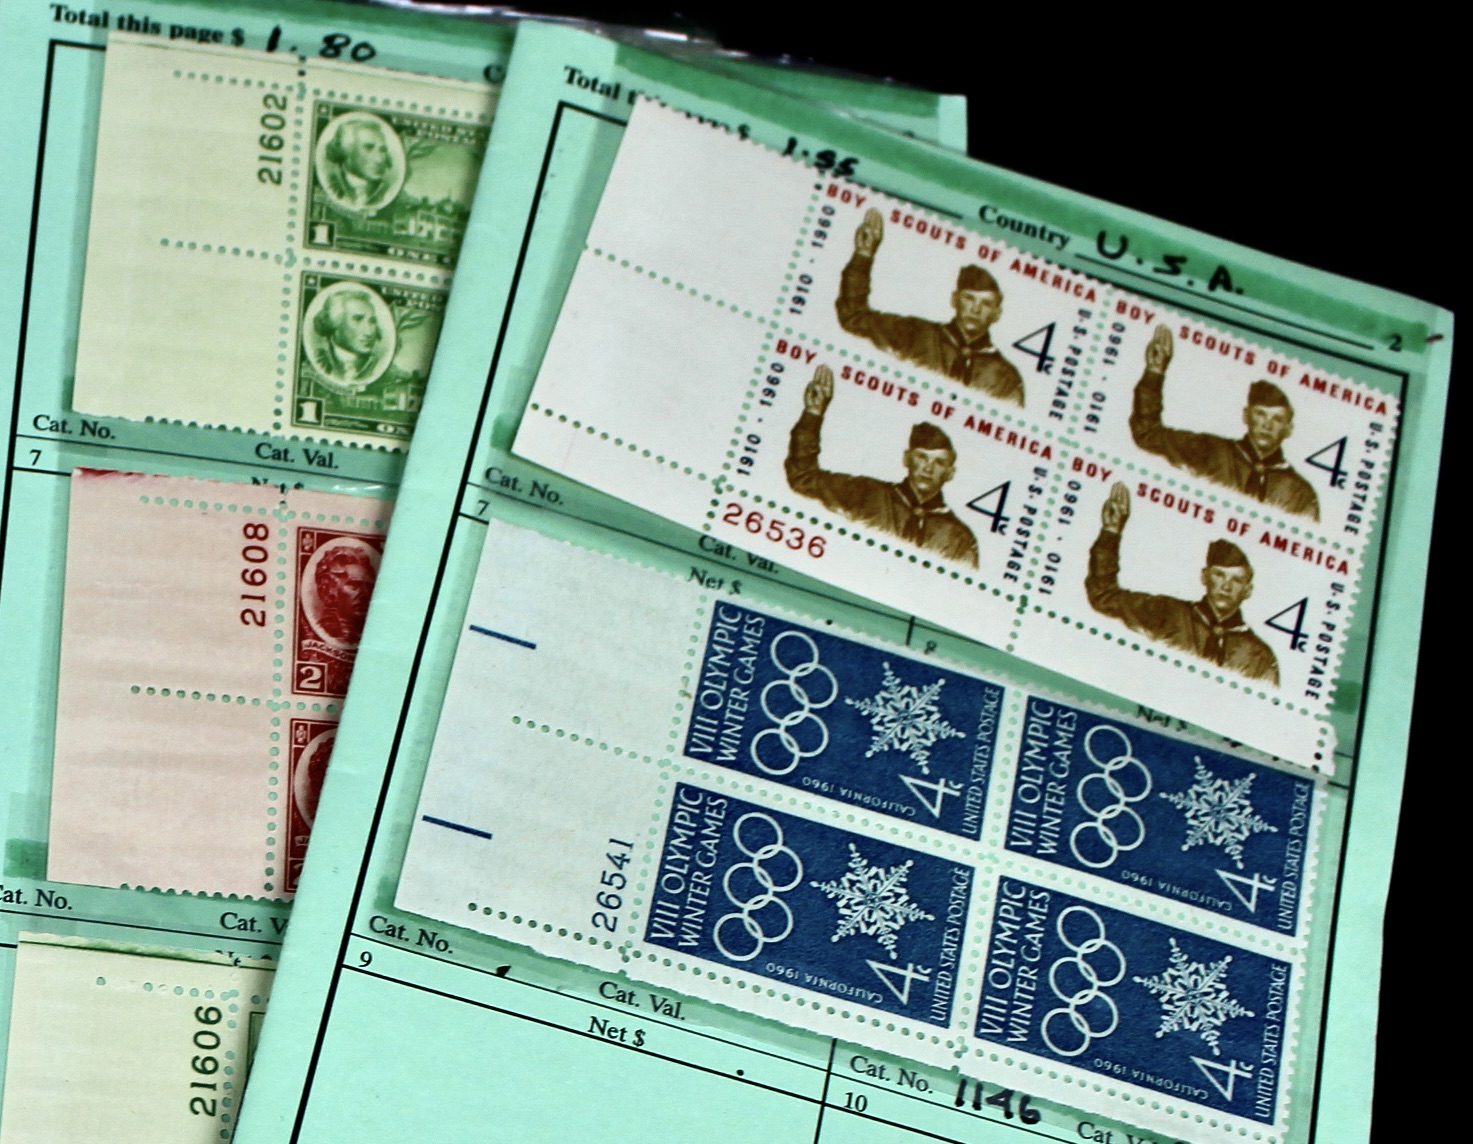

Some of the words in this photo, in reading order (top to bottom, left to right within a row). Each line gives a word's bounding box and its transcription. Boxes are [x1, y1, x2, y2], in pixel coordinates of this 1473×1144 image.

[49, 4, 109, 28] Total
[117, 11, 161, 34] this
[165, 22, 224, 45] page
[230, 27, 245, 46] $
[563, 65, 621, 101] Total
[256, 93, 288, 186] 21602
[826, 184, 866, 209] BOY
[890, 210, 966, 250] SCOUTS
[979, 246, 1001, 263] OF
[1011, 259, 1096, 301] AMERICA
[979, 205, 1070, 252] Country
[1096, 230, 1245, 296] U.S.A.
[1115, 300, 1156, 325] BOY
[1179, 325, 1256, 366] SCOUTS
[1267, 361, 1290, 379] OF
[1299, 373, 1388, 416] AMERICA
[1389, 335, 1402, 351] 2
[1049, 344, 1082, 421] POSTAGE
[32, 414, 73, 434] Cat.
[79, 420, 116, 441] No.
[301, 401, 319, 421] 1
[30, 451, 41, 466] 7
[254, 443, 295, 463] Cat.
[302, 449, 339, 470] Val.
[484, 466, 522, 493] Cat.
[530, 481, 564, 507] No.
[722, 502, 827, 560] 26536
[1071, 457, 1113, 483] BOY
[1136, 482, 1215, 525] SCOUTS
[1227, 517, 1251, 537] OF
[1259, 531, 1349, 576] AMERICA
[240, 522, 269, 626] 21608
[701, 605, 742, 709] OLYMPIC
[732, 614, 765, 686] GAMES
[299, 665, 323, 689] 2
[689, 712, 719, 756] VIII
[717, 687, 750, 764] WINTER
[1050, 710, 1077, 780] GAMES
[1018, 700, 1054, 804] OLYMPIC
[661, 787, 704, 895] OLYMPIC
[695, 797, 728, 869] GAMES
[1010, 804, 1037, 848] VIII
[1037, 781, 1065, 855] WINTER
[35, 889, 73, 910] No.
[591, 838, 634, 933] 26541
[678, 870, 713, 948] WINTER
[949, 867, 970, 927] POSTAGE
[369, 915, 410, 943] Cat.
[416, 929, 454, 955] No.
[651, 896, 681, 940] VIII
[358, 950, 372, 968] 9
[940, 925, 960, 970] STATES
[599, 982, 639, 1007] Cat.
[649, 995, 686, 1020] Val.
[806, 972, 883, 1004] CALIFORNIA
[931, 969, 951, 1021] UNITED
[588, 1017, 628, 1043] Net
[632, 1029, 647, 1047] $
[190, 1005, 223, 1117] 21606
[850, 1055, 891, 1083] Cat.
[896, 1067, 934, 1095] No.
[844, 1092, 868, 1113] 10
[955, 1079, 1042, 1126] 1146
